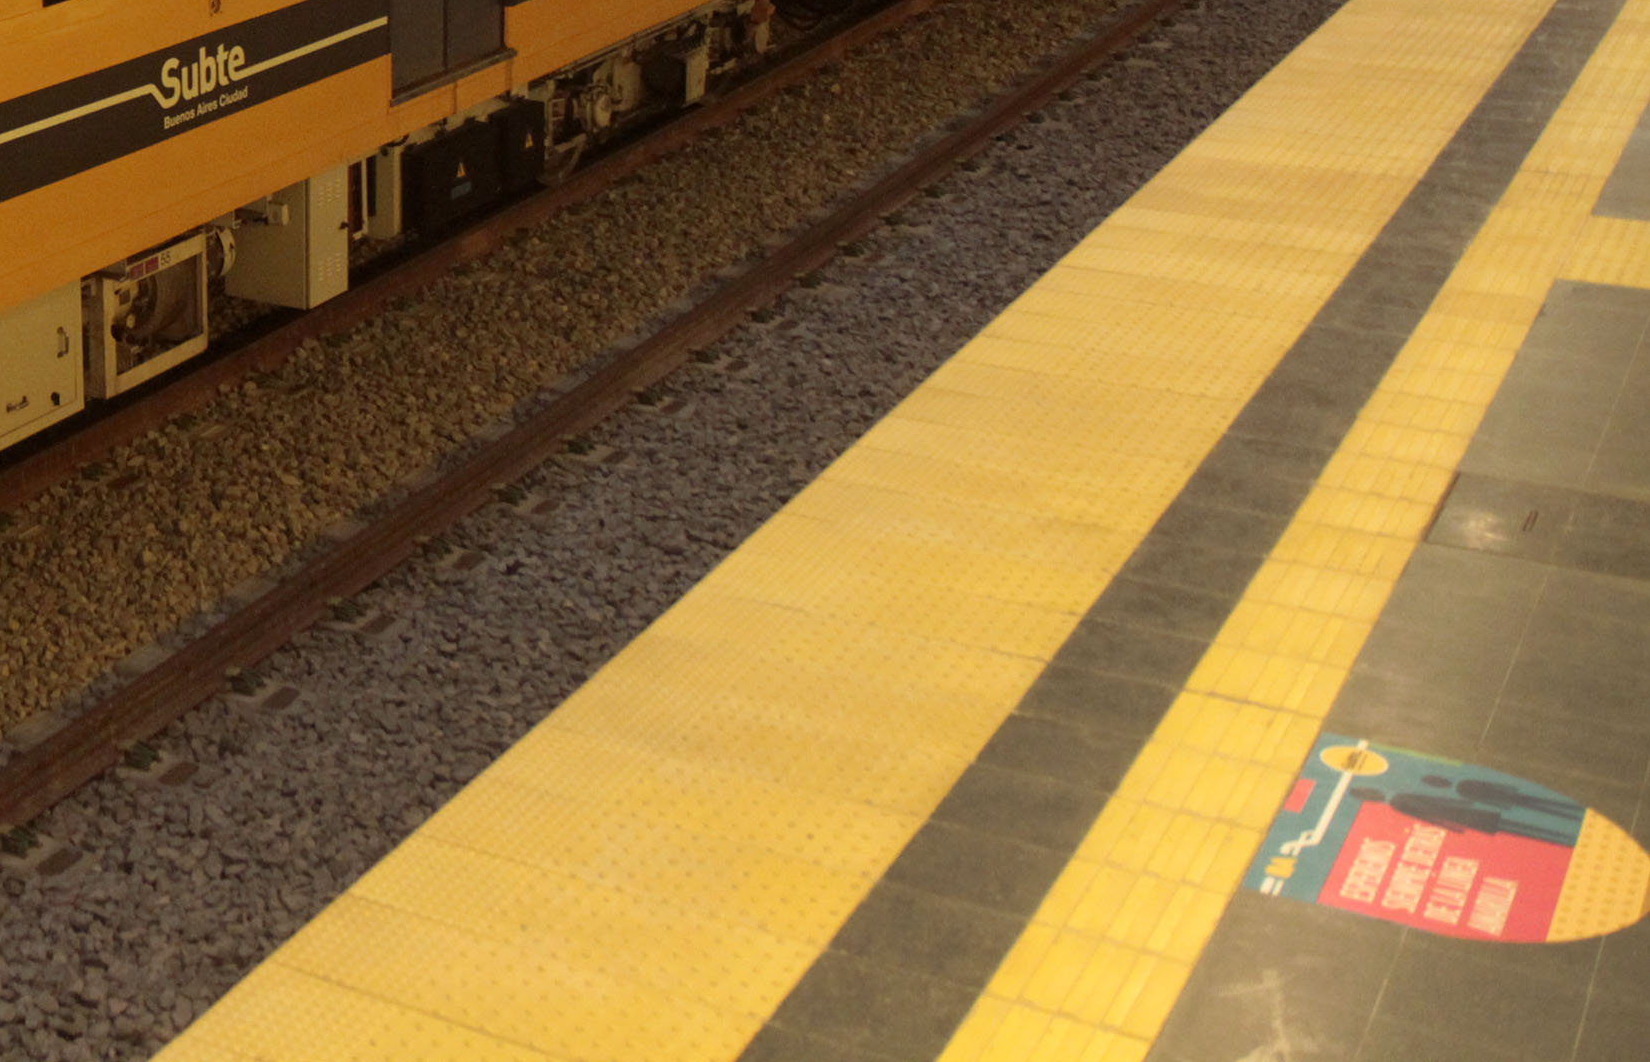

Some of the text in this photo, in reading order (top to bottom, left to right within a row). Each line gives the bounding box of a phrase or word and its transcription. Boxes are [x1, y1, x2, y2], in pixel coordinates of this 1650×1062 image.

[161, 43, 246, 110] Subte
[163, 85, 249, 130] Buenos Aires Ciudad
